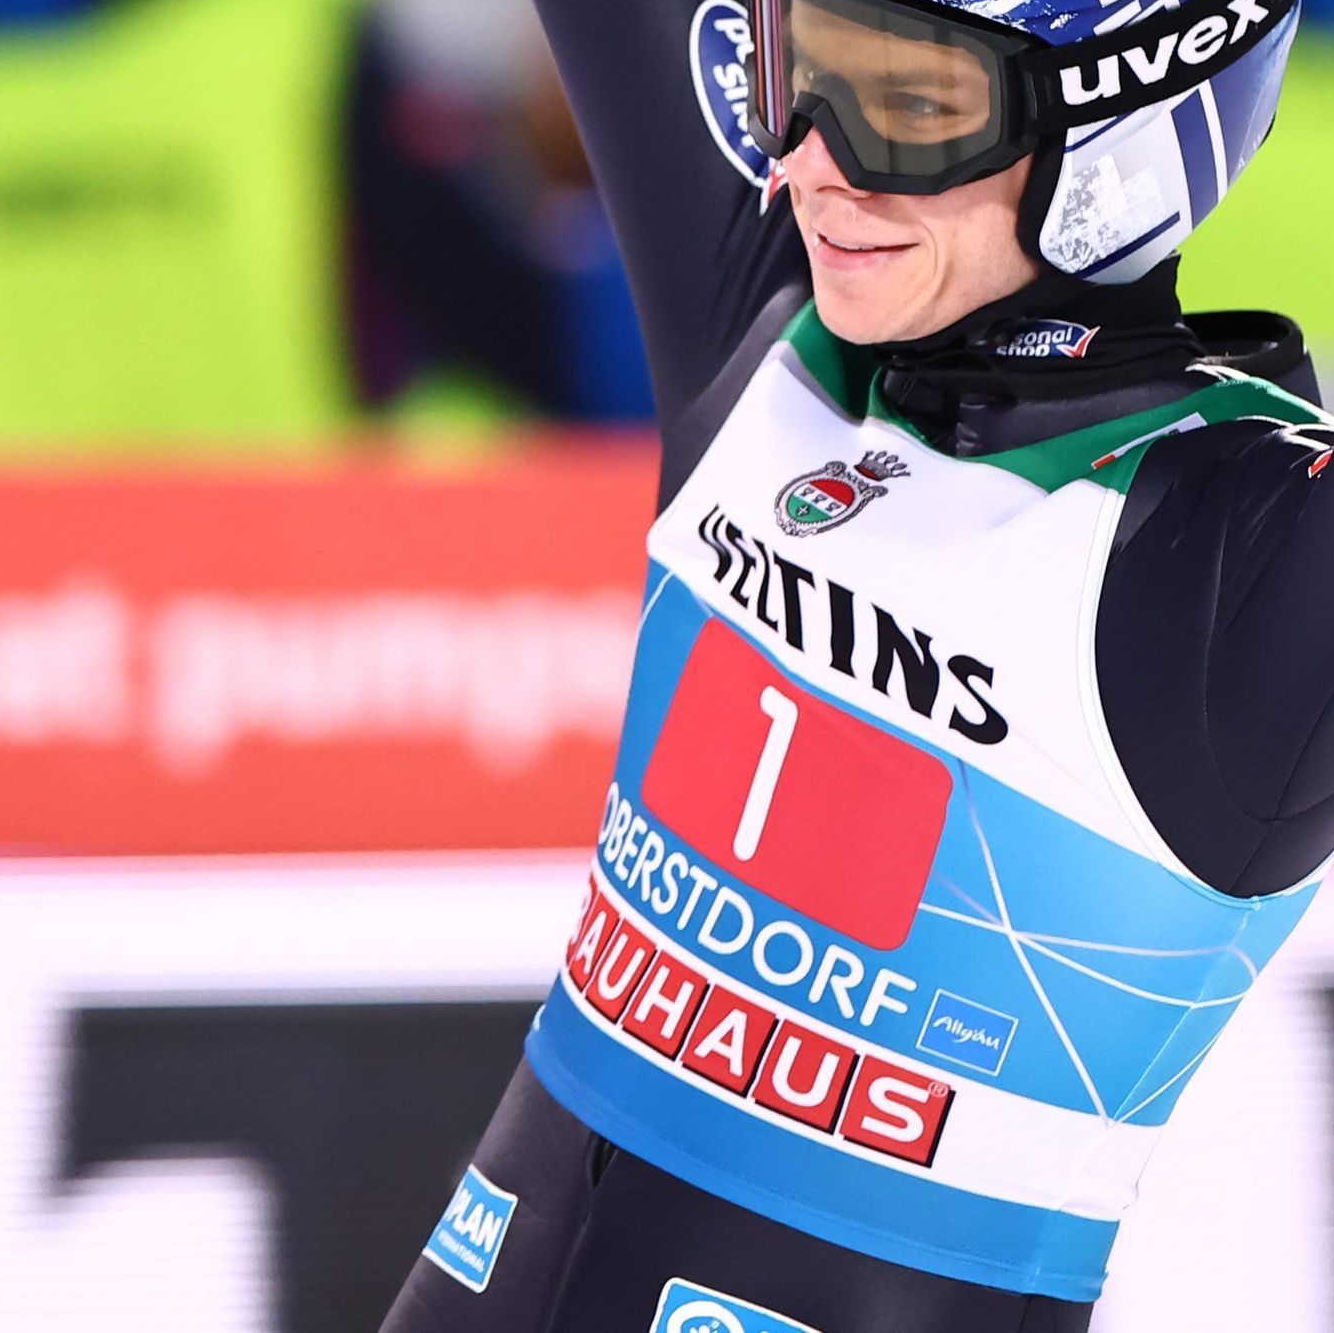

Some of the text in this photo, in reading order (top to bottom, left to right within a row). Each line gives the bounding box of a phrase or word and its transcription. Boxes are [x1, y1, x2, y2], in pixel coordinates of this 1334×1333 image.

[1014, 326, 1074, 346] sonal
[697, 503, 1009, 746] VELTINS
[732, 684, 799, 862] 1
[597, 780, 918, 1027] OBERSTDORF
[932, 1015, 1001, 1051] Allgäu
